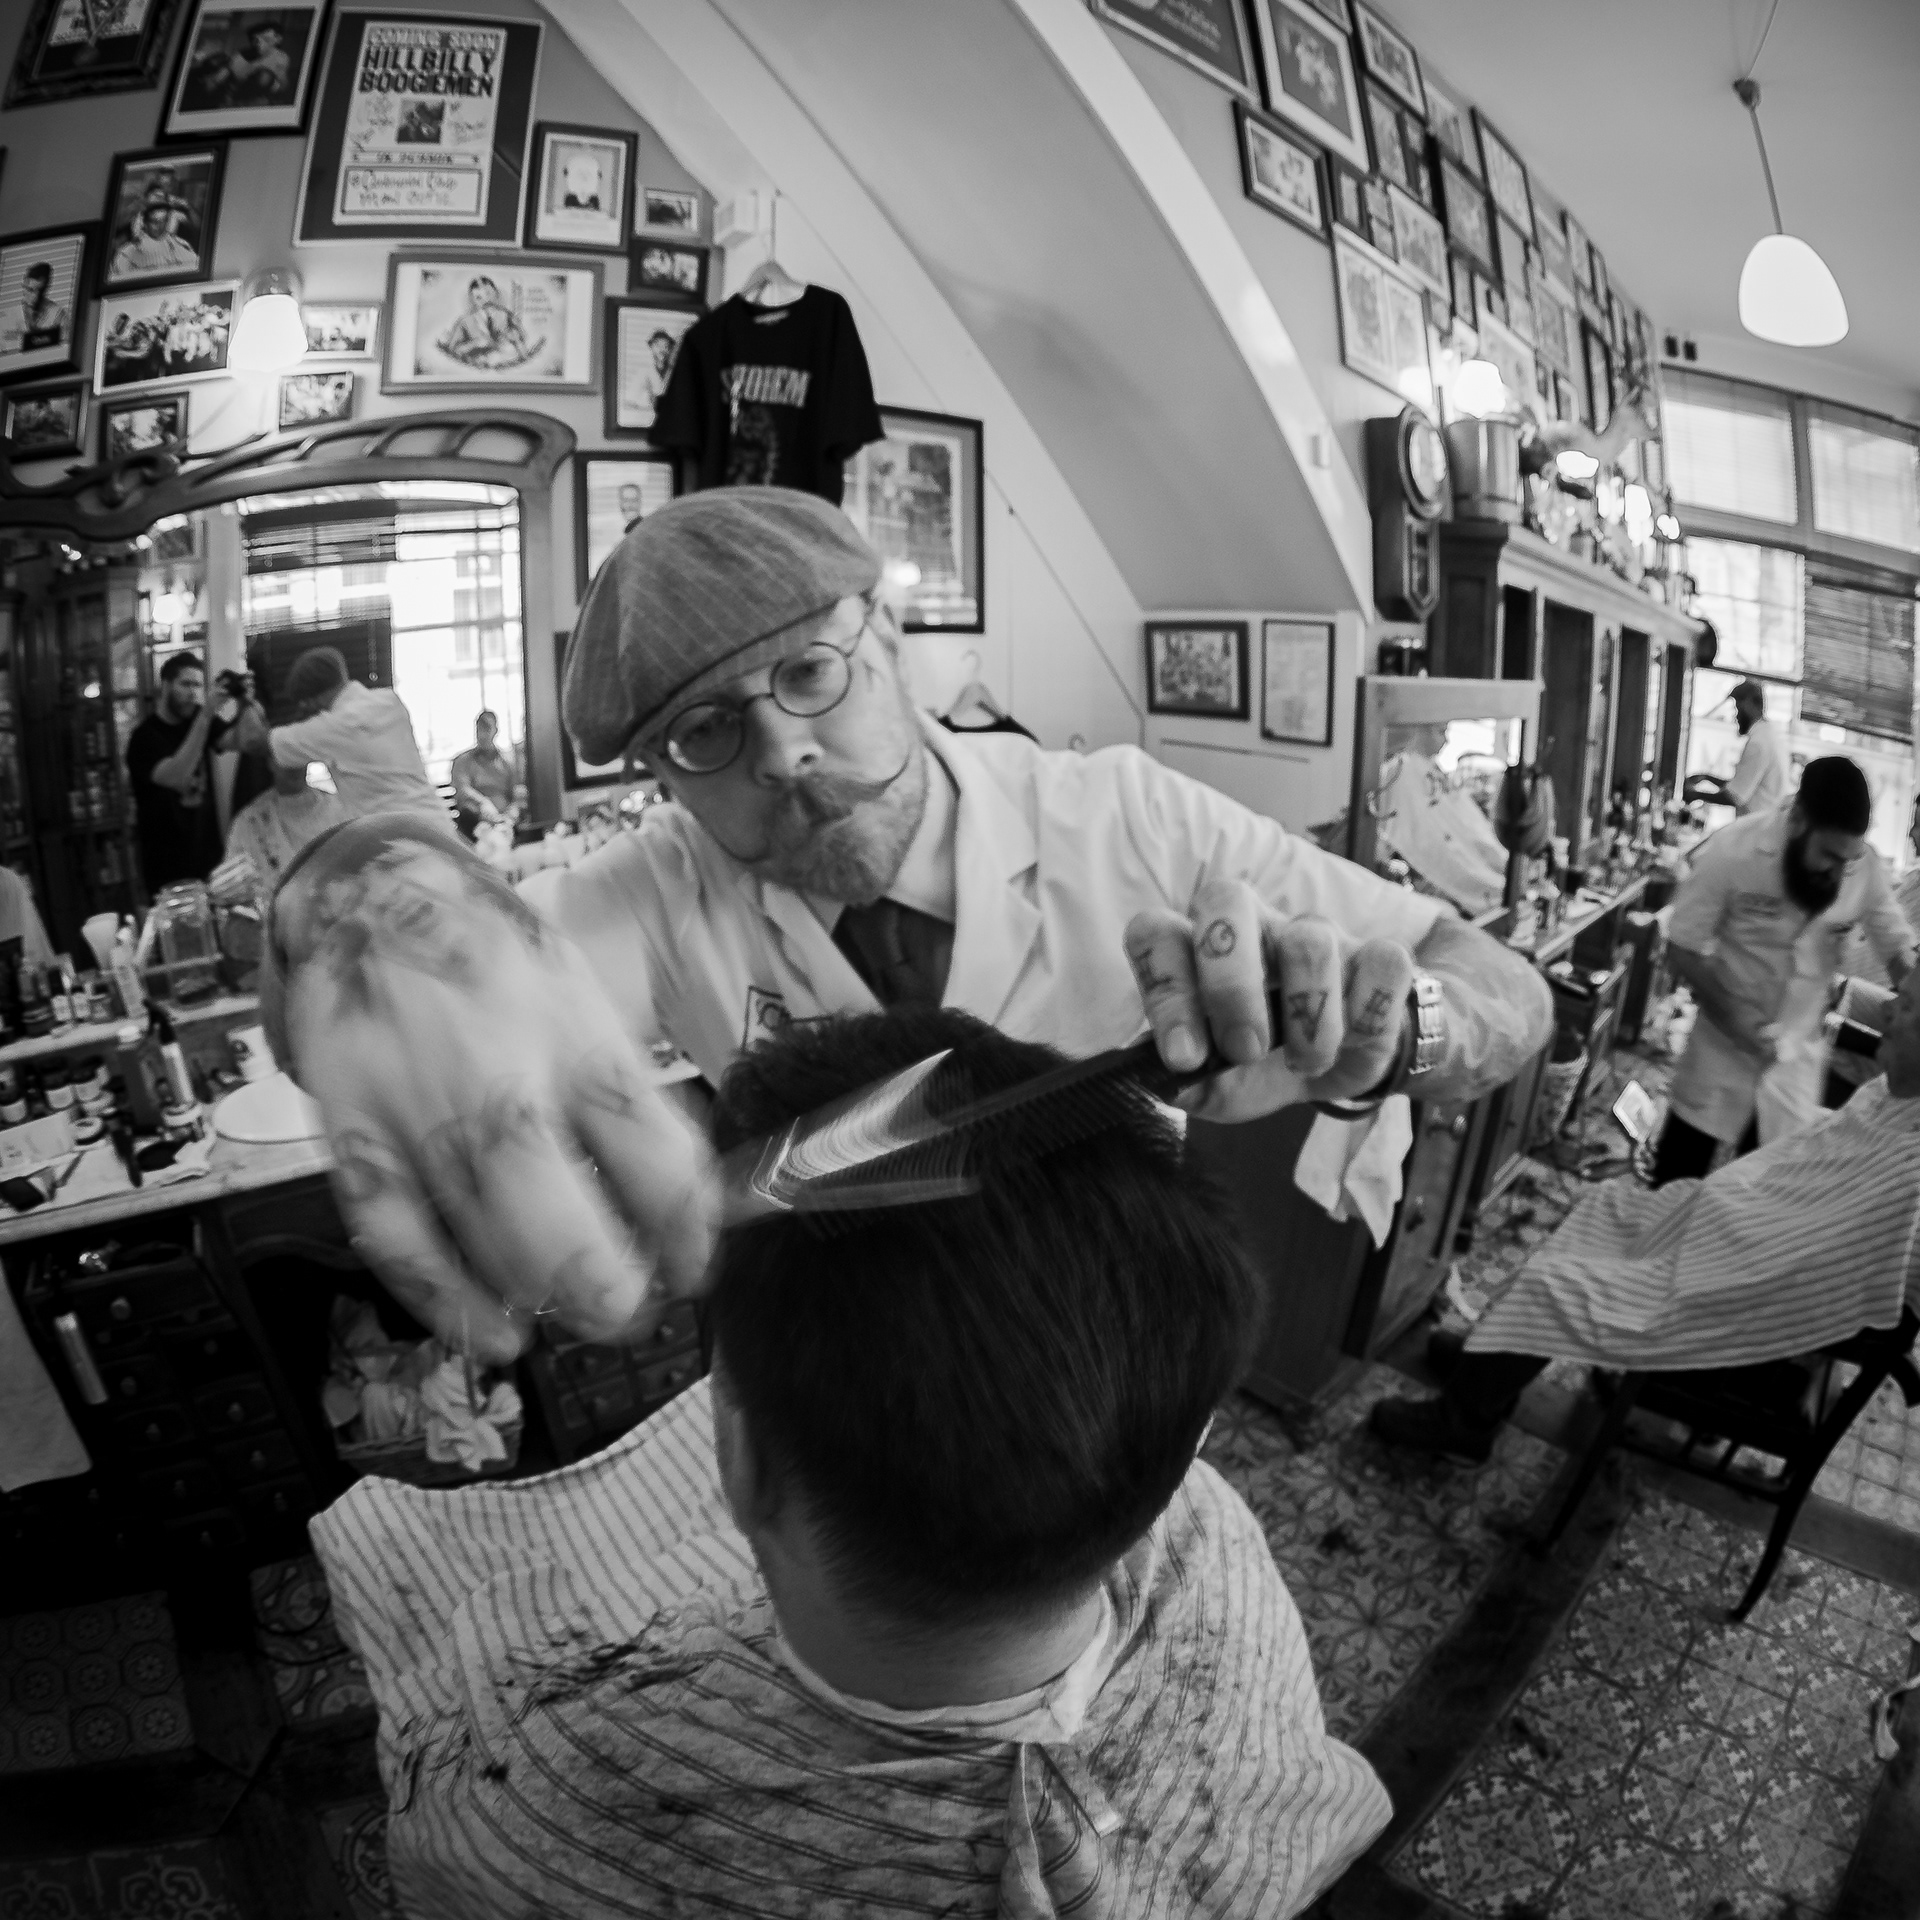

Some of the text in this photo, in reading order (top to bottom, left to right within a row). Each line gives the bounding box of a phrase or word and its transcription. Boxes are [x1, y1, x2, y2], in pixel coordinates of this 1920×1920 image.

[367, 27, 501, 51] COMING SOON
[363, 45, 498, 76] HILLBILLY
[359, 71, 494, 97] BOOGIEMEN
